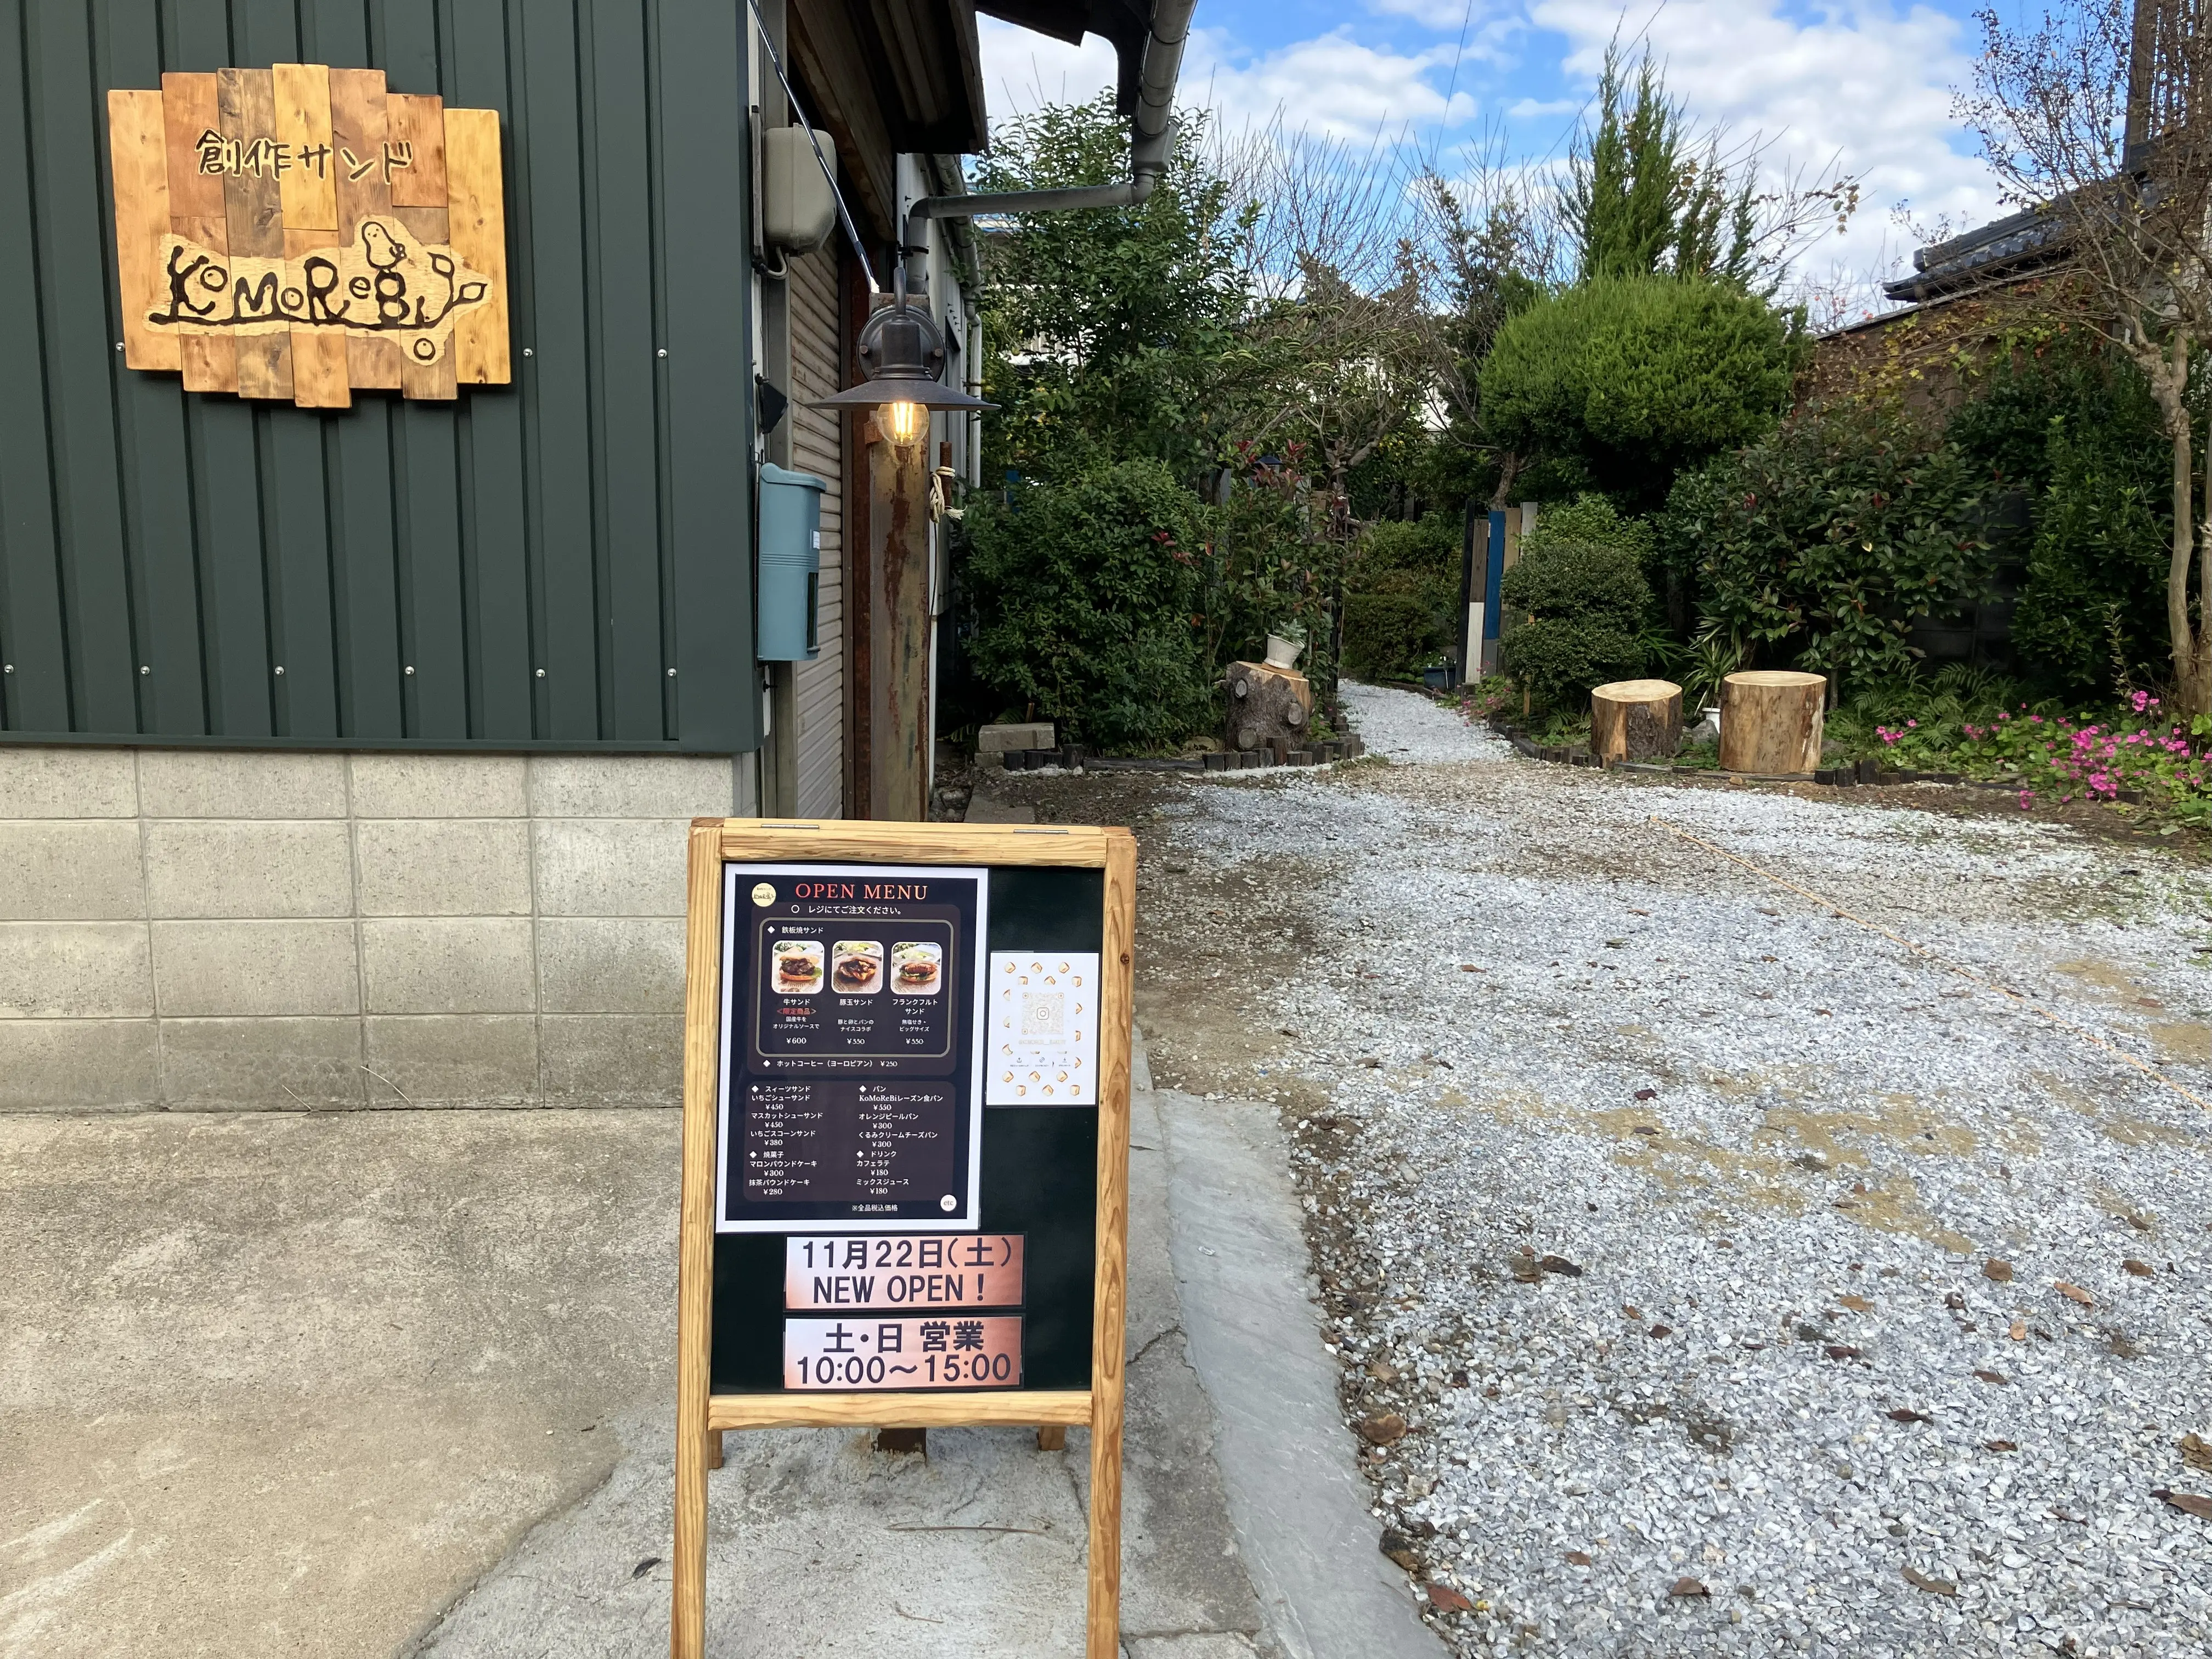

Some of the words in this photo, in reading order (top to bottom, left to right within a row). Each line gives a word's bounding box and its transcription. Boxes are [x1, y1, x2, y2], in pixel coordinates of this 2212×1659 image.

[196, 129, 413, 184] 創作サンド
[795, 884, 855, 899] OPEN
[864, 885, 928, 900] MENU
[809, 905, 901, 915] レジにてご注文ください。
[803, 1237, 1012, 1269] 11月22日（土）
[814, 1276, 874, 1304] NEW
[823, 1323, 902, 1353] 土・日
[919, 1321, 984, 1352] 営業
[798, 1353, 1012, 1384] 10:00～15:00
